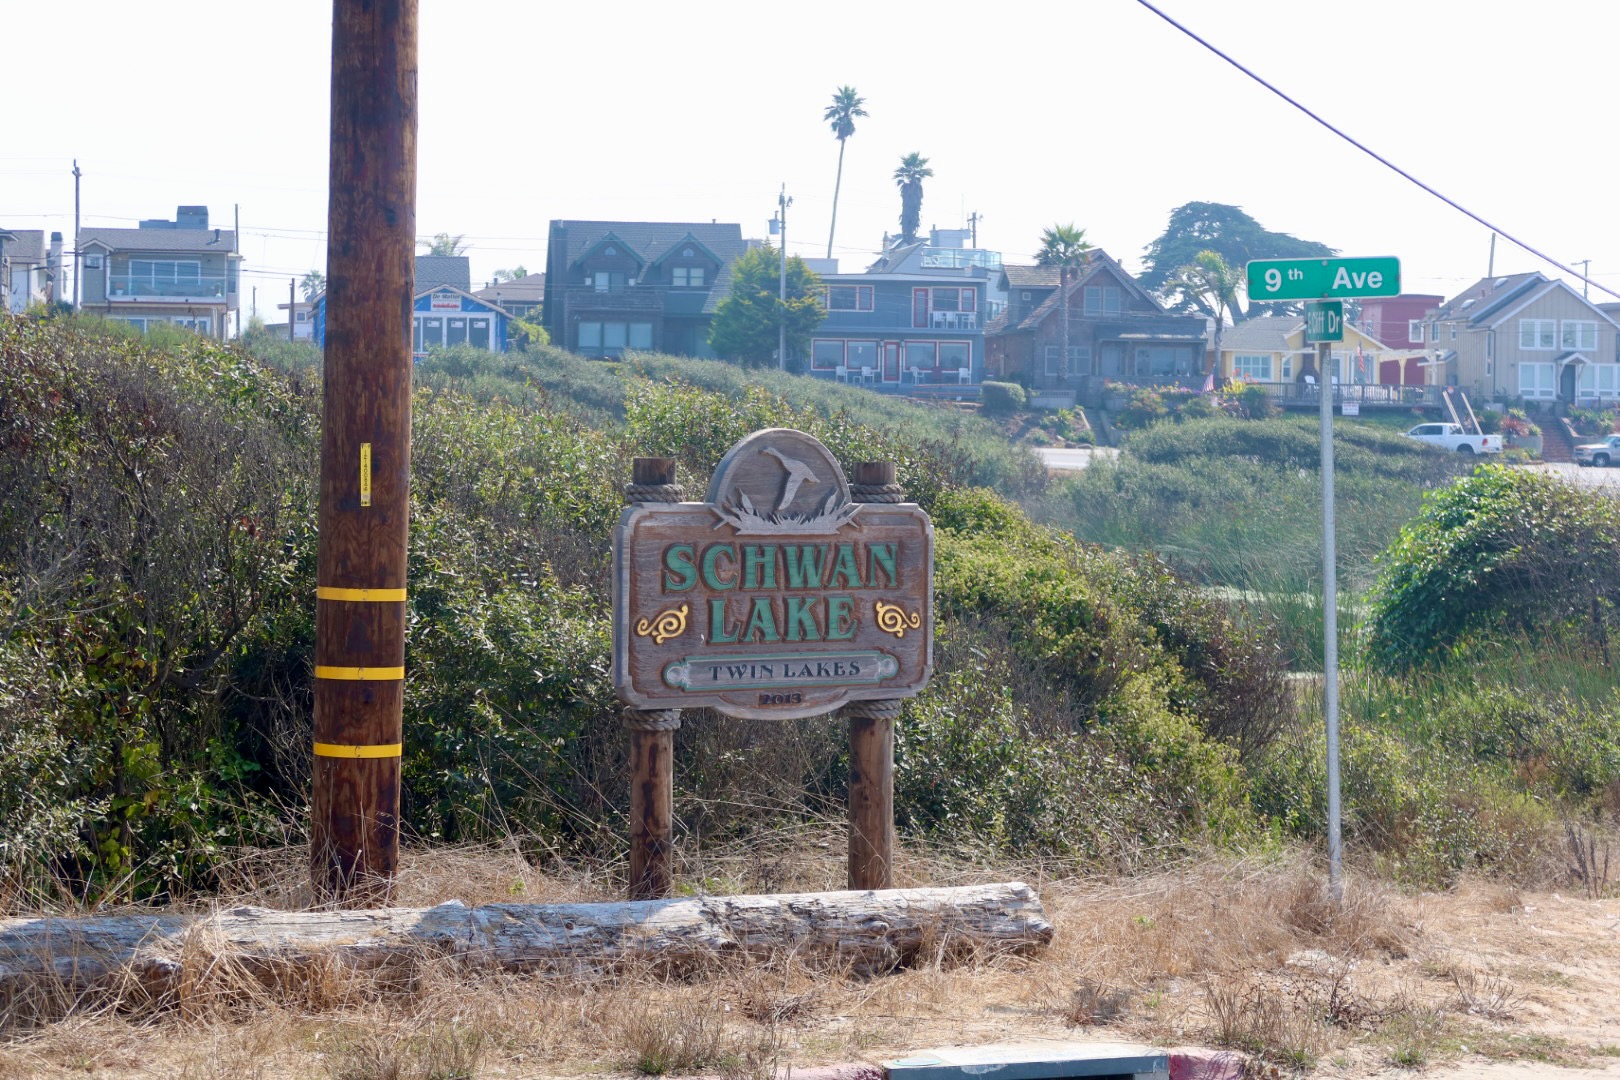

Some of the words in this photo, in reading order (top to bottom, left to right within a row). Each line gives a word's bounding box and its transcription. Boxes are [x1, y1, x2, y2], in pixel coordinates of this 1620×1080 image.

[1331, 266, 1383, 290] Ave
[1328, 310, 1341, 334] Dr
[663, 543, 899, 593] SCHWAN
[708, 596, 858, 644] LAKE
[708, 663, 774, 681] TWIN
[783, 661, 861, 678] LAKES
[759, 692, 802, 705] 2013
